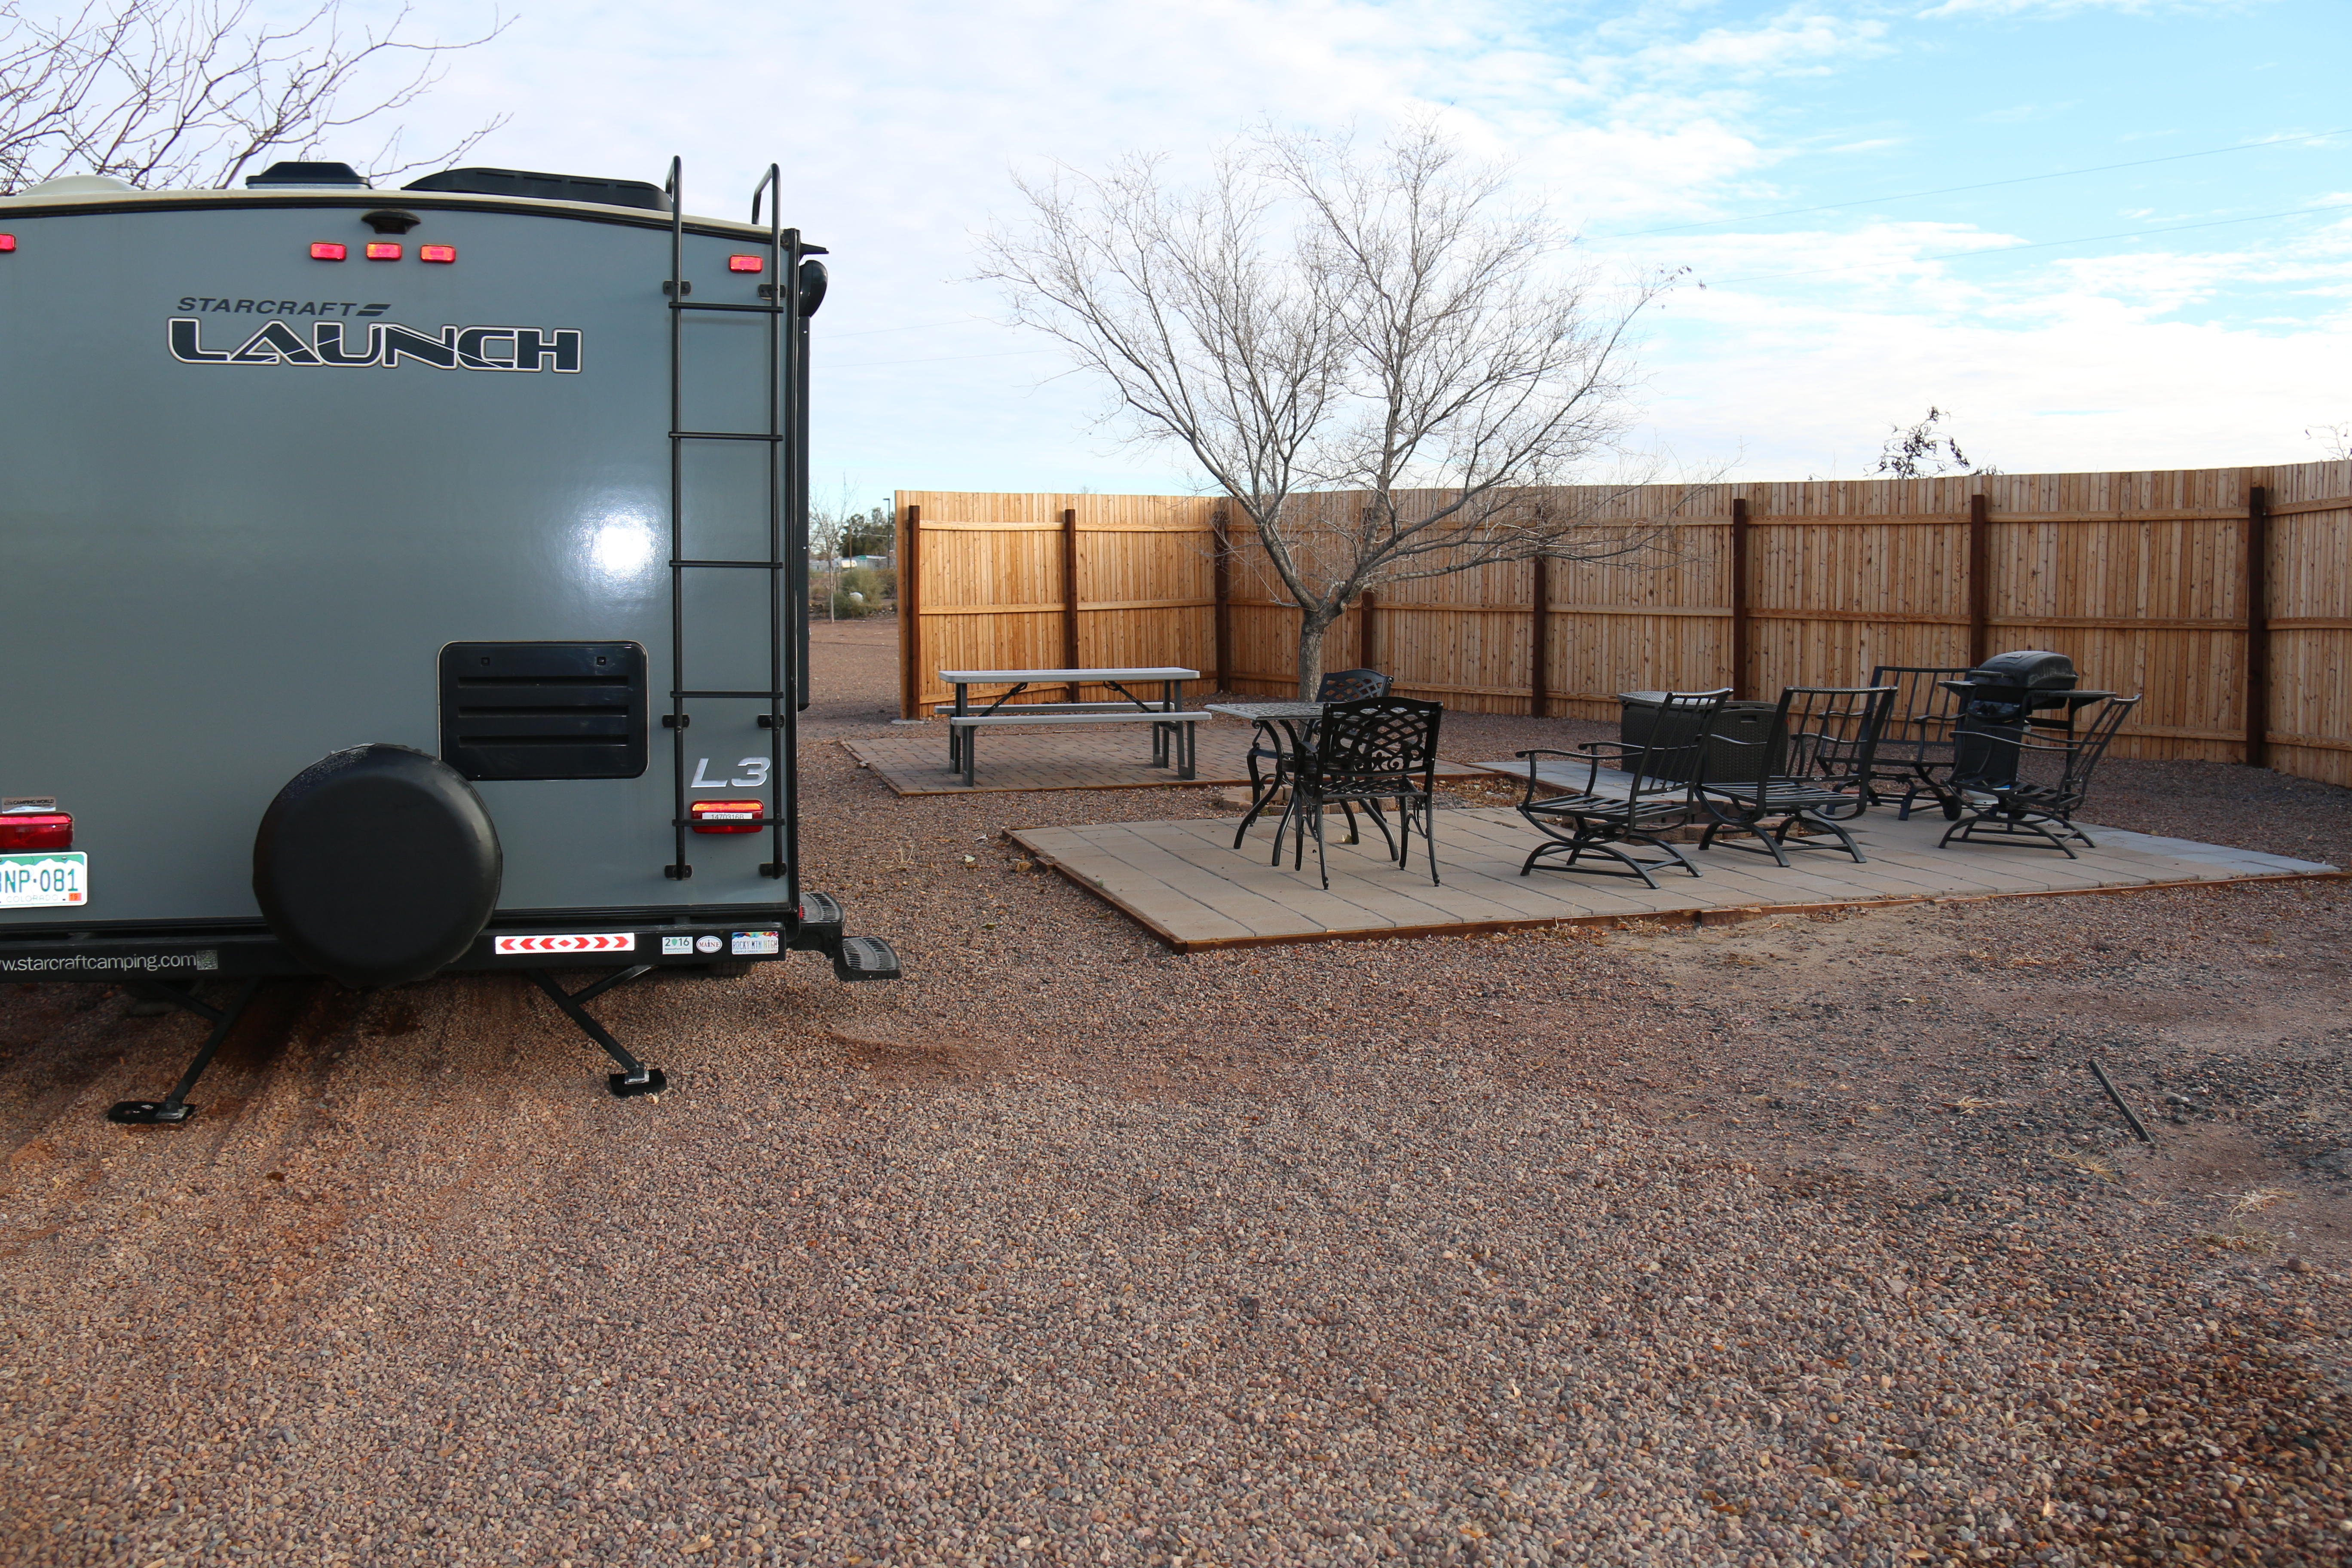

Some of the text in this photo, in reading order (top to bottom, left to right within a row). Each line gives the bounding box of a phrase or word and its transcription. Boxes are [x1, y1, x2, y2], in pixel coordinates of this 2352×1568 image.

[178, 297, 356, 316] STARCRAFT
[167, 316, 582, 373] LAUNCH
[690, 756, 771, 788] L3
[6, 894, 58, 903] COLORADO
[699, 939, 720, 947] MAINE
[732, 940, 750, 950] ROCKY
[752, 940, 762, 949] MTN
[0, 954, 196, 971] w.starcraftcamping.com
